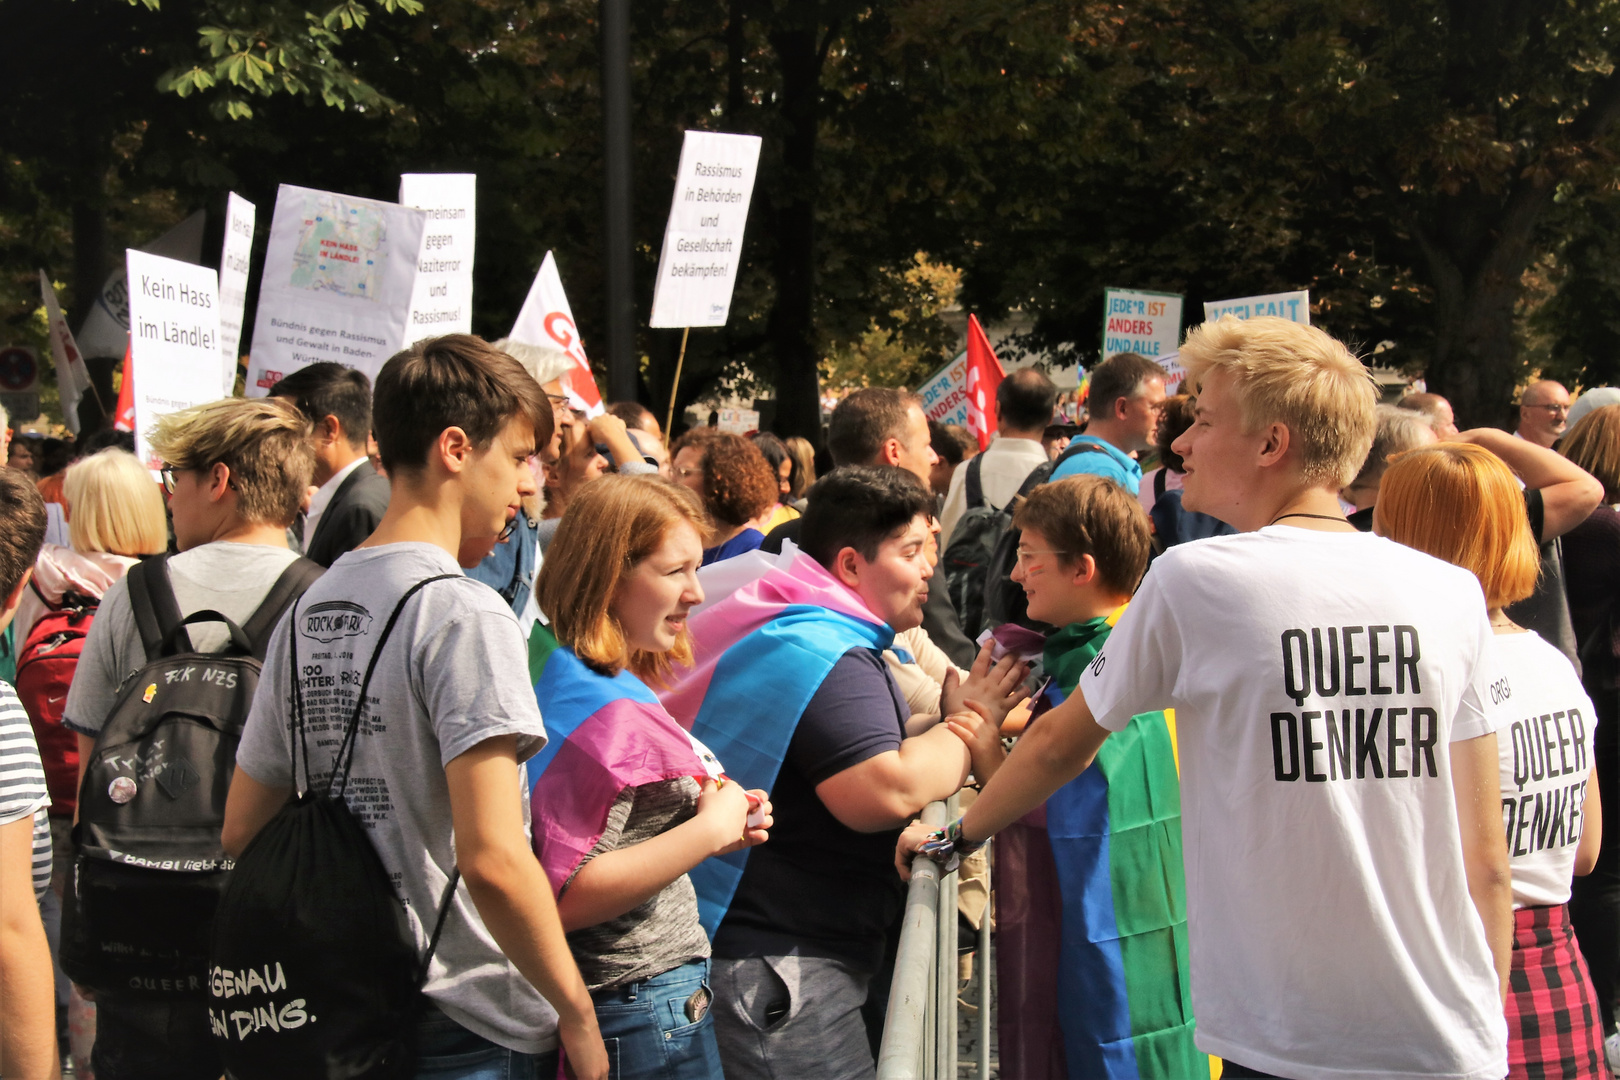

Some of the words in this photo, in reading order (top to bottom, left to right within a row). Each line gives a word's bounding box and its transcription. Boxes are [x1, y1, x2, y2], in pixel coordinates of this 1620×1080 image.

[695, 162, 742, 178] Rassismus
[685, 187, 695, 201] in
[696, 187, 742, 203] Behörden
[415, 205, 466, 219] meinsam
[700, 214, 719, 228] und
[320, 239, 337, 248] KEIN
[339, 243, 358, 252] HASS
[426, 234, 453, 250] gegen
[677, 238, 732, 253] Gesellschaft
[671, 262, 728, 280] bekämpfen!
[142, 274, 175, 300] Kein
[180, 283, 211, 309] Hass
[429, 282, 448, 297] und
[412, 306, 461, 324] Rassismus!
[1147, 301, 1166, 317] IST
[1213, 299, 1300, 322] VELFALT
[138, 316, 158, 341] im
[163, 321, 216, 350] Ländle!
[270, 318, 307, 332] Bündnis
[309, 326, 337, 338] gegen
[339, 330, 387, 346] Rassismus
[1107, 318, 1153, 336] ANDERS
[276, 335, 294, 344] und
[296, 338, 329, 351] Gewalt
[331, 344, 341, 353] in
[342, 346, 376, 358] Baden-
[1106, 337, 1131, 353] UND
[1132, 340, 1160, 356] ALLE
[307, 616, 333, 632] ROCK
[1281, 625, 1422, 707] QUEER
[164, 667, 196, 685] FCK
[202, 668, 238, 689] NZS
[1270, 707, 1438, 782] DENKER
[1511, 708, 1586, 792] QUEER
[1502, 778, 1587, 858] DENKE
[123, 853, 180, 871] BAMBI
[183, 858, 216, 872] liebt
[128, 975, 201, 992] QUEER
[230, 998, 317, 1041] DING.
